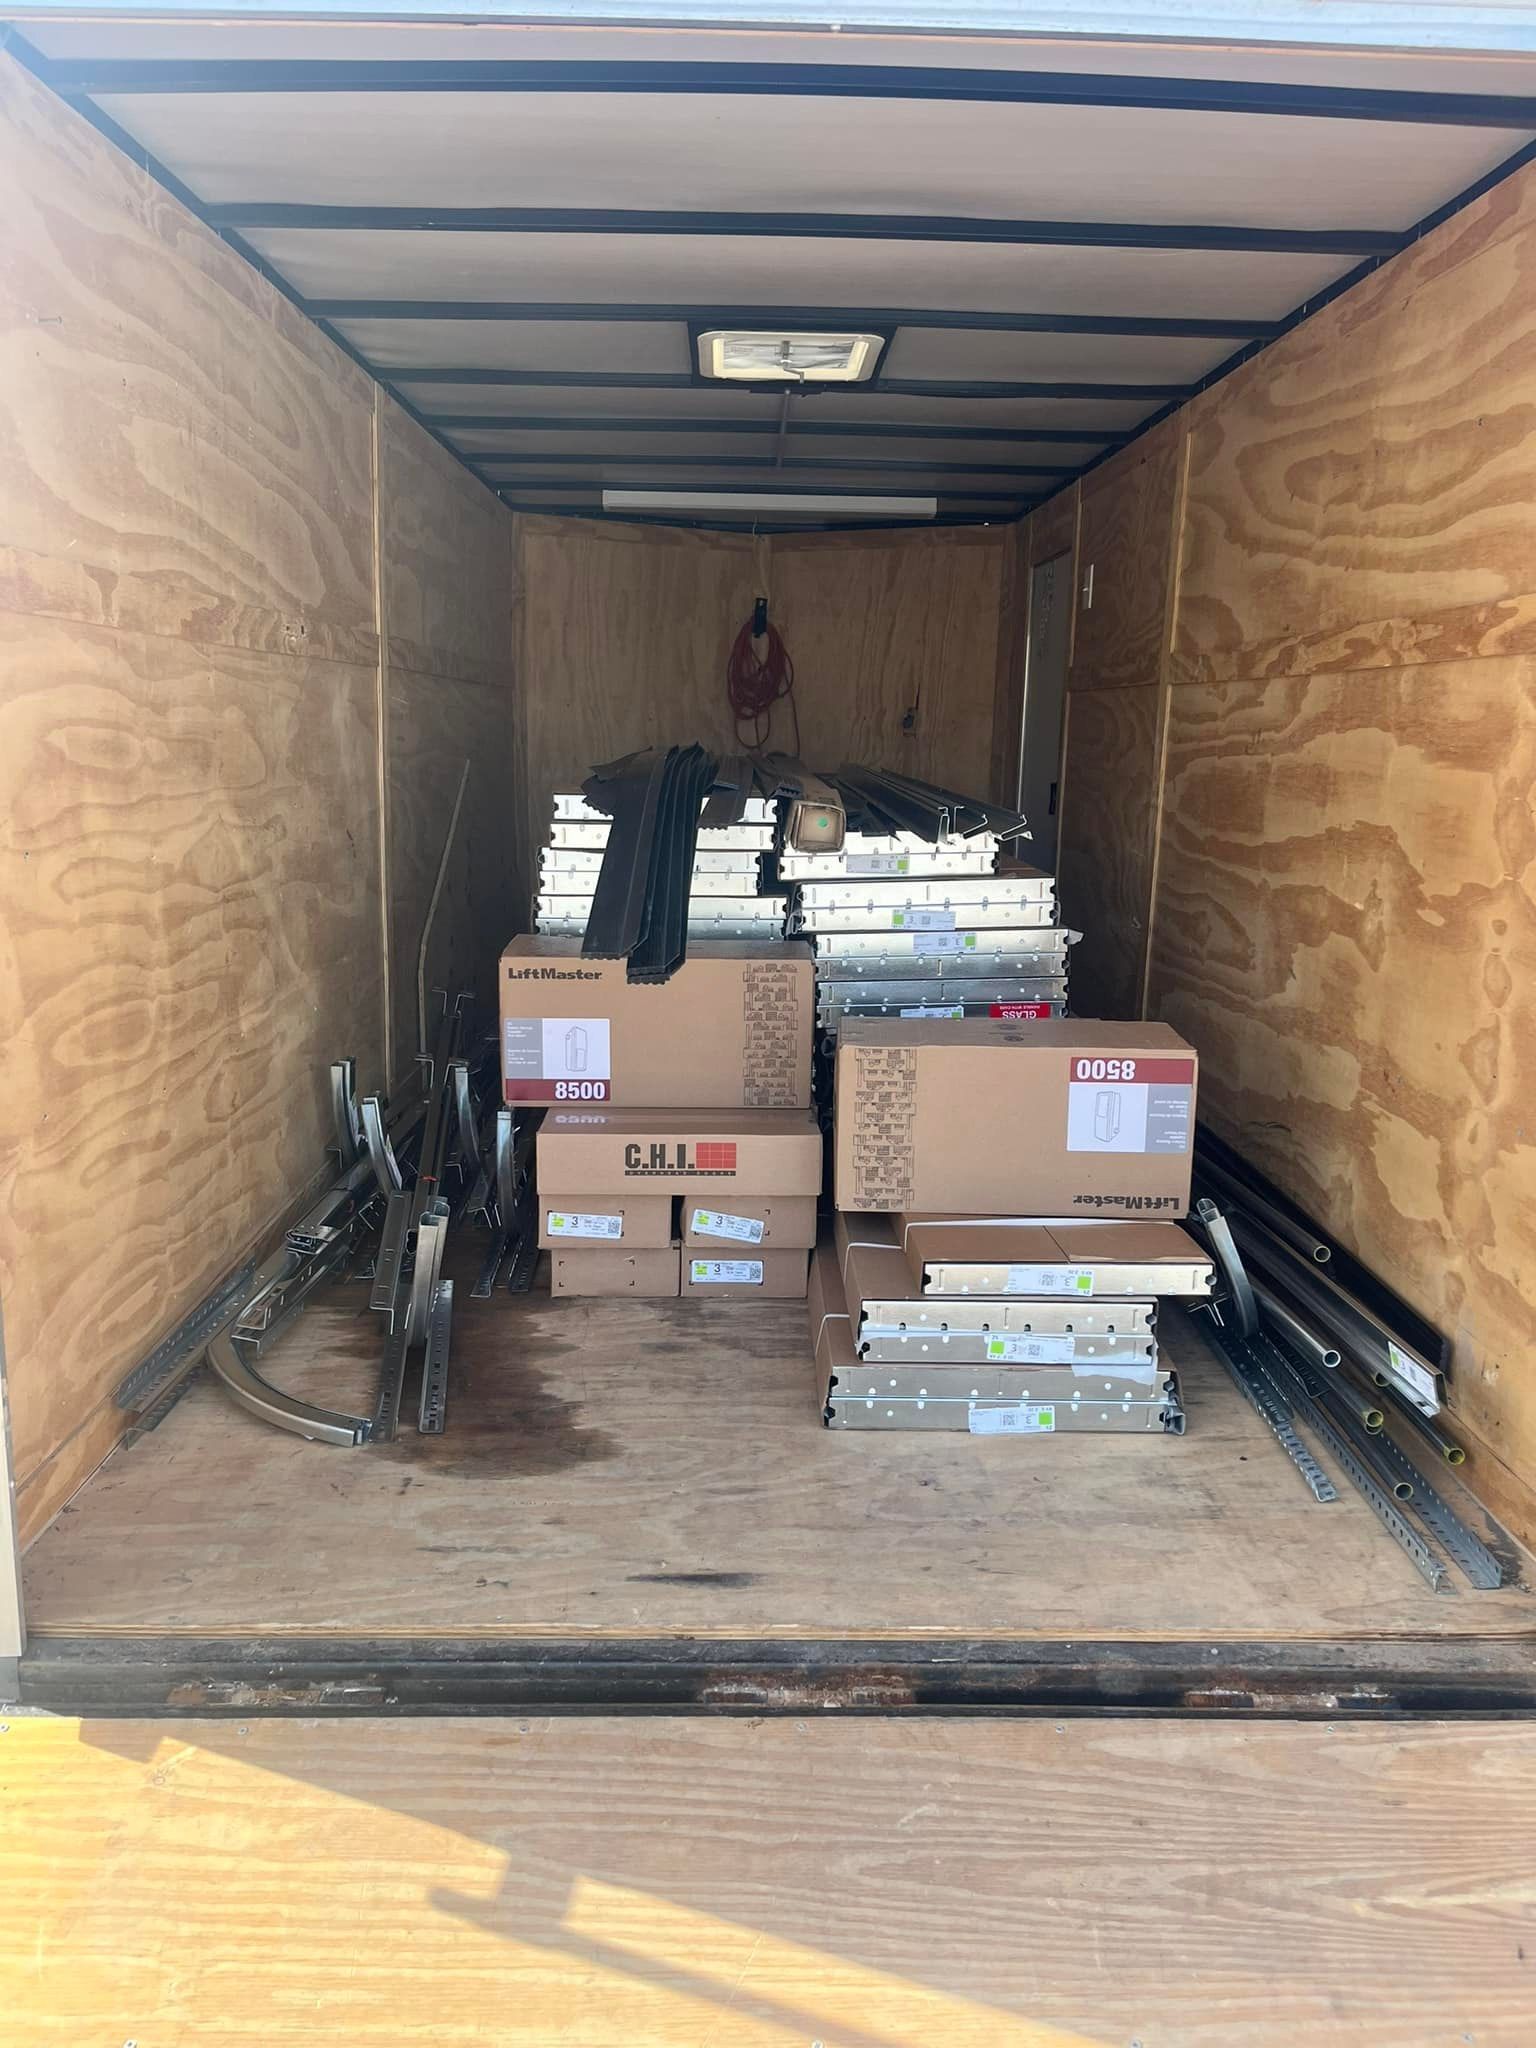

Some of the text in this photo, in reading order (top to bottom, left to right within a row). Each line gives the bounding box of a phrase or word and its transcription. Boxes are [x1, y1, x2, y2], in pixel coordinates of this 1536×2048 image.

[508, 968, 602, 980] LiftMaster
[1002, 1010, 1037, 1019] GLASS
[1077, 1059, 1136, 1080] 8500
[555, 1082, 606, 1100] 8500
[625, 1143, 695, 1170] C.H.I.
[1073, 1194, 1180, 1210] LiftMaster
[571, 1216, 579, 1226] 3
[716, 1216, 724, 1226] 3
[714, 1263, 721, 1273] 3
